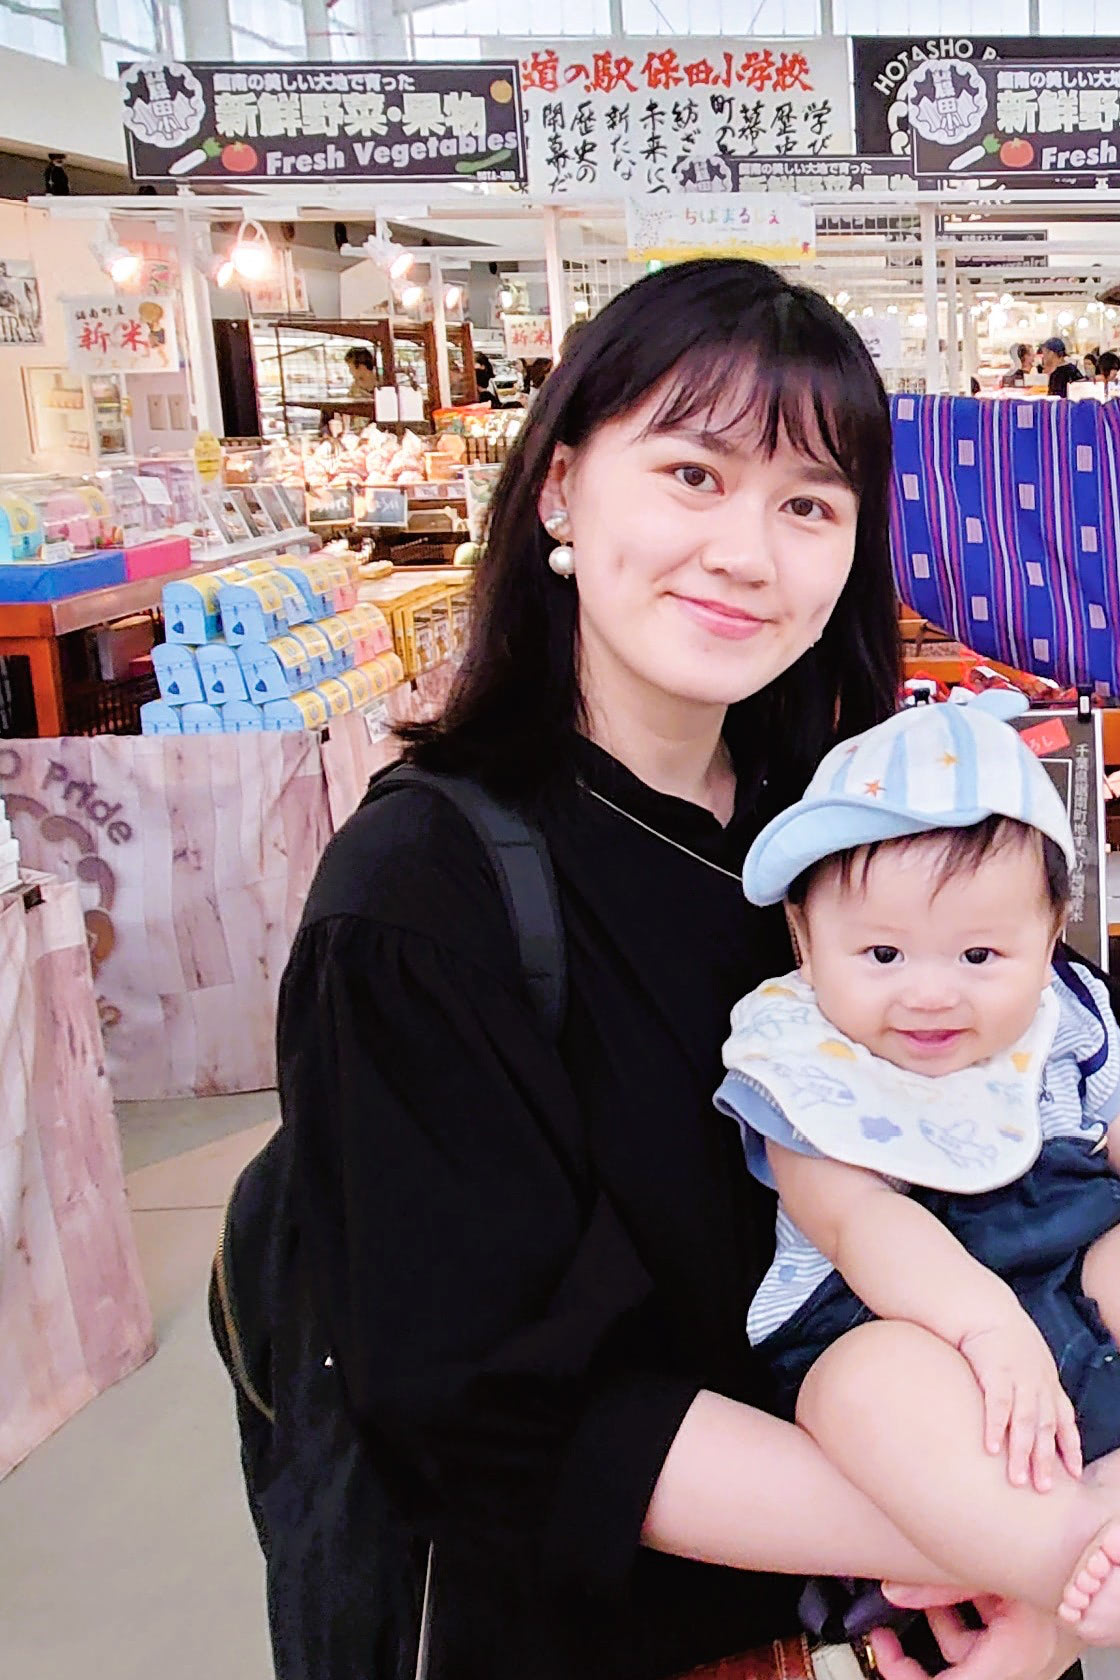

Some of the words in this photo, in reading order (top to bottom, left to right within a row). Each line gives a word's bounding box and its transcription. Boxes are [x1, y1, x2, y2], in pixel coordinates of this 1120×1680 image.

[522, 48, 814, 93] 道の駅保田小学校
[873, 38, 974, 97] HOTASHO
[214, 91, 487, 137] 新鮮野菜・果物
[266, 145, 345, 176] Fresh
[353, 131, 517, 168] Vegetables
[570, 100, 598, 183] 歴史の
[605, 102, 636, 181] 新たな
[1041, 139, 1117, 171] Fresh
[78, 319, 150, 353] 新米
